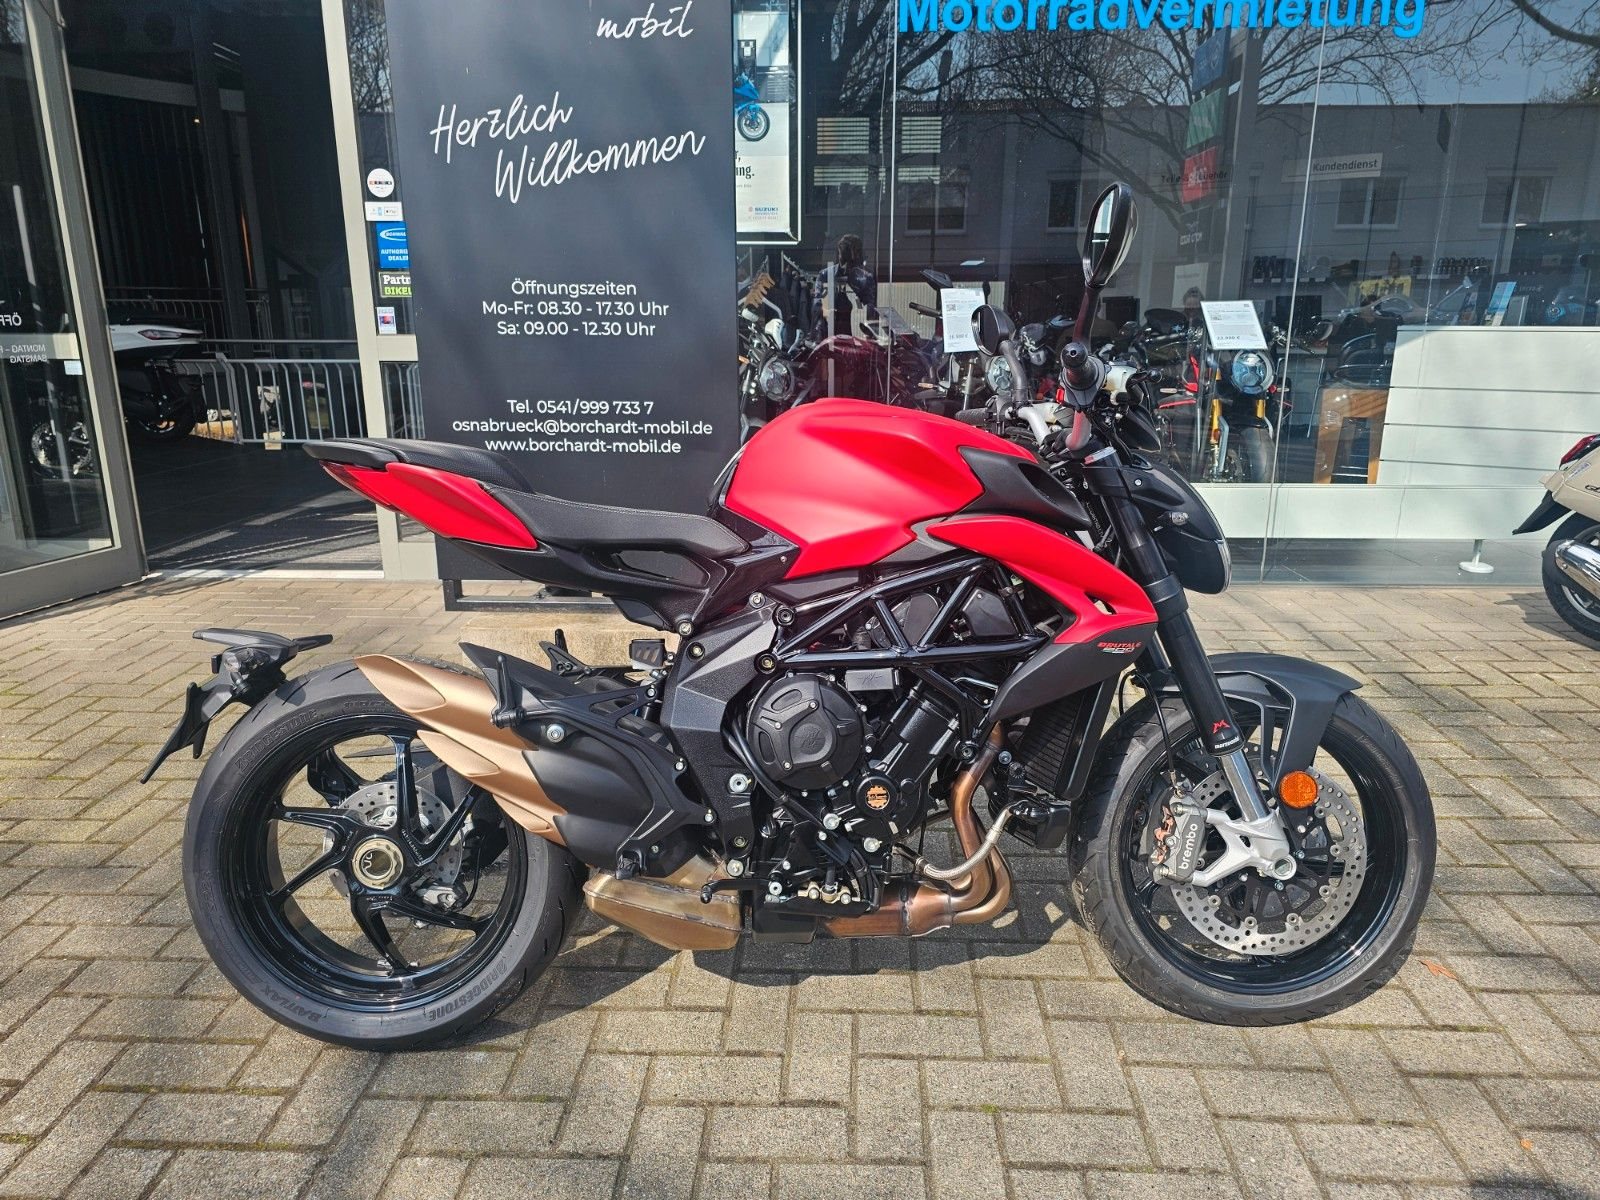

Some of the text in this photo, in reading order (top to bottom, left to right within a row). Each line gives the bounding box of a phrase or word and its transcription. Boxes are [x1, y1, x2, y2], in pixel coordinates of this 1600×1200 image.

[597, 0, 694, 39] mobil
[899, 0, 1425, 38] Motorradvermietung
[429, 91, 573, 164] Herzlich
[495, 130, 706, 203] Willkommen
[1312, 158, 1378, 173] Kundendienst
[511, 278, 637, 298] Öffnungszeiten
[482, 300, 534, 315] Mo-Fr:
[537, 301, 582, 315] 08.30
[595, 301, 635, 315] 17.30
[639, 301, 670, 316] Uhr
[497, 321, 520, 335] Sa:
[523, 321, 569, 335] 09.00
[582, 322, 622, 336] 12.30
[626, 322, 656, 336] Uhr
[507, 398, 654, 415] Tel. 0541/999 733 7
[452, 419, 713, 436] osnabrueck@borchardt-mobil.de
[484, 438, 682, 453] www.borchardt-mobil.de
[1178, 823, 1199, 870] brembo
[427, 960, 508, 1022] BRIDGESTONE
